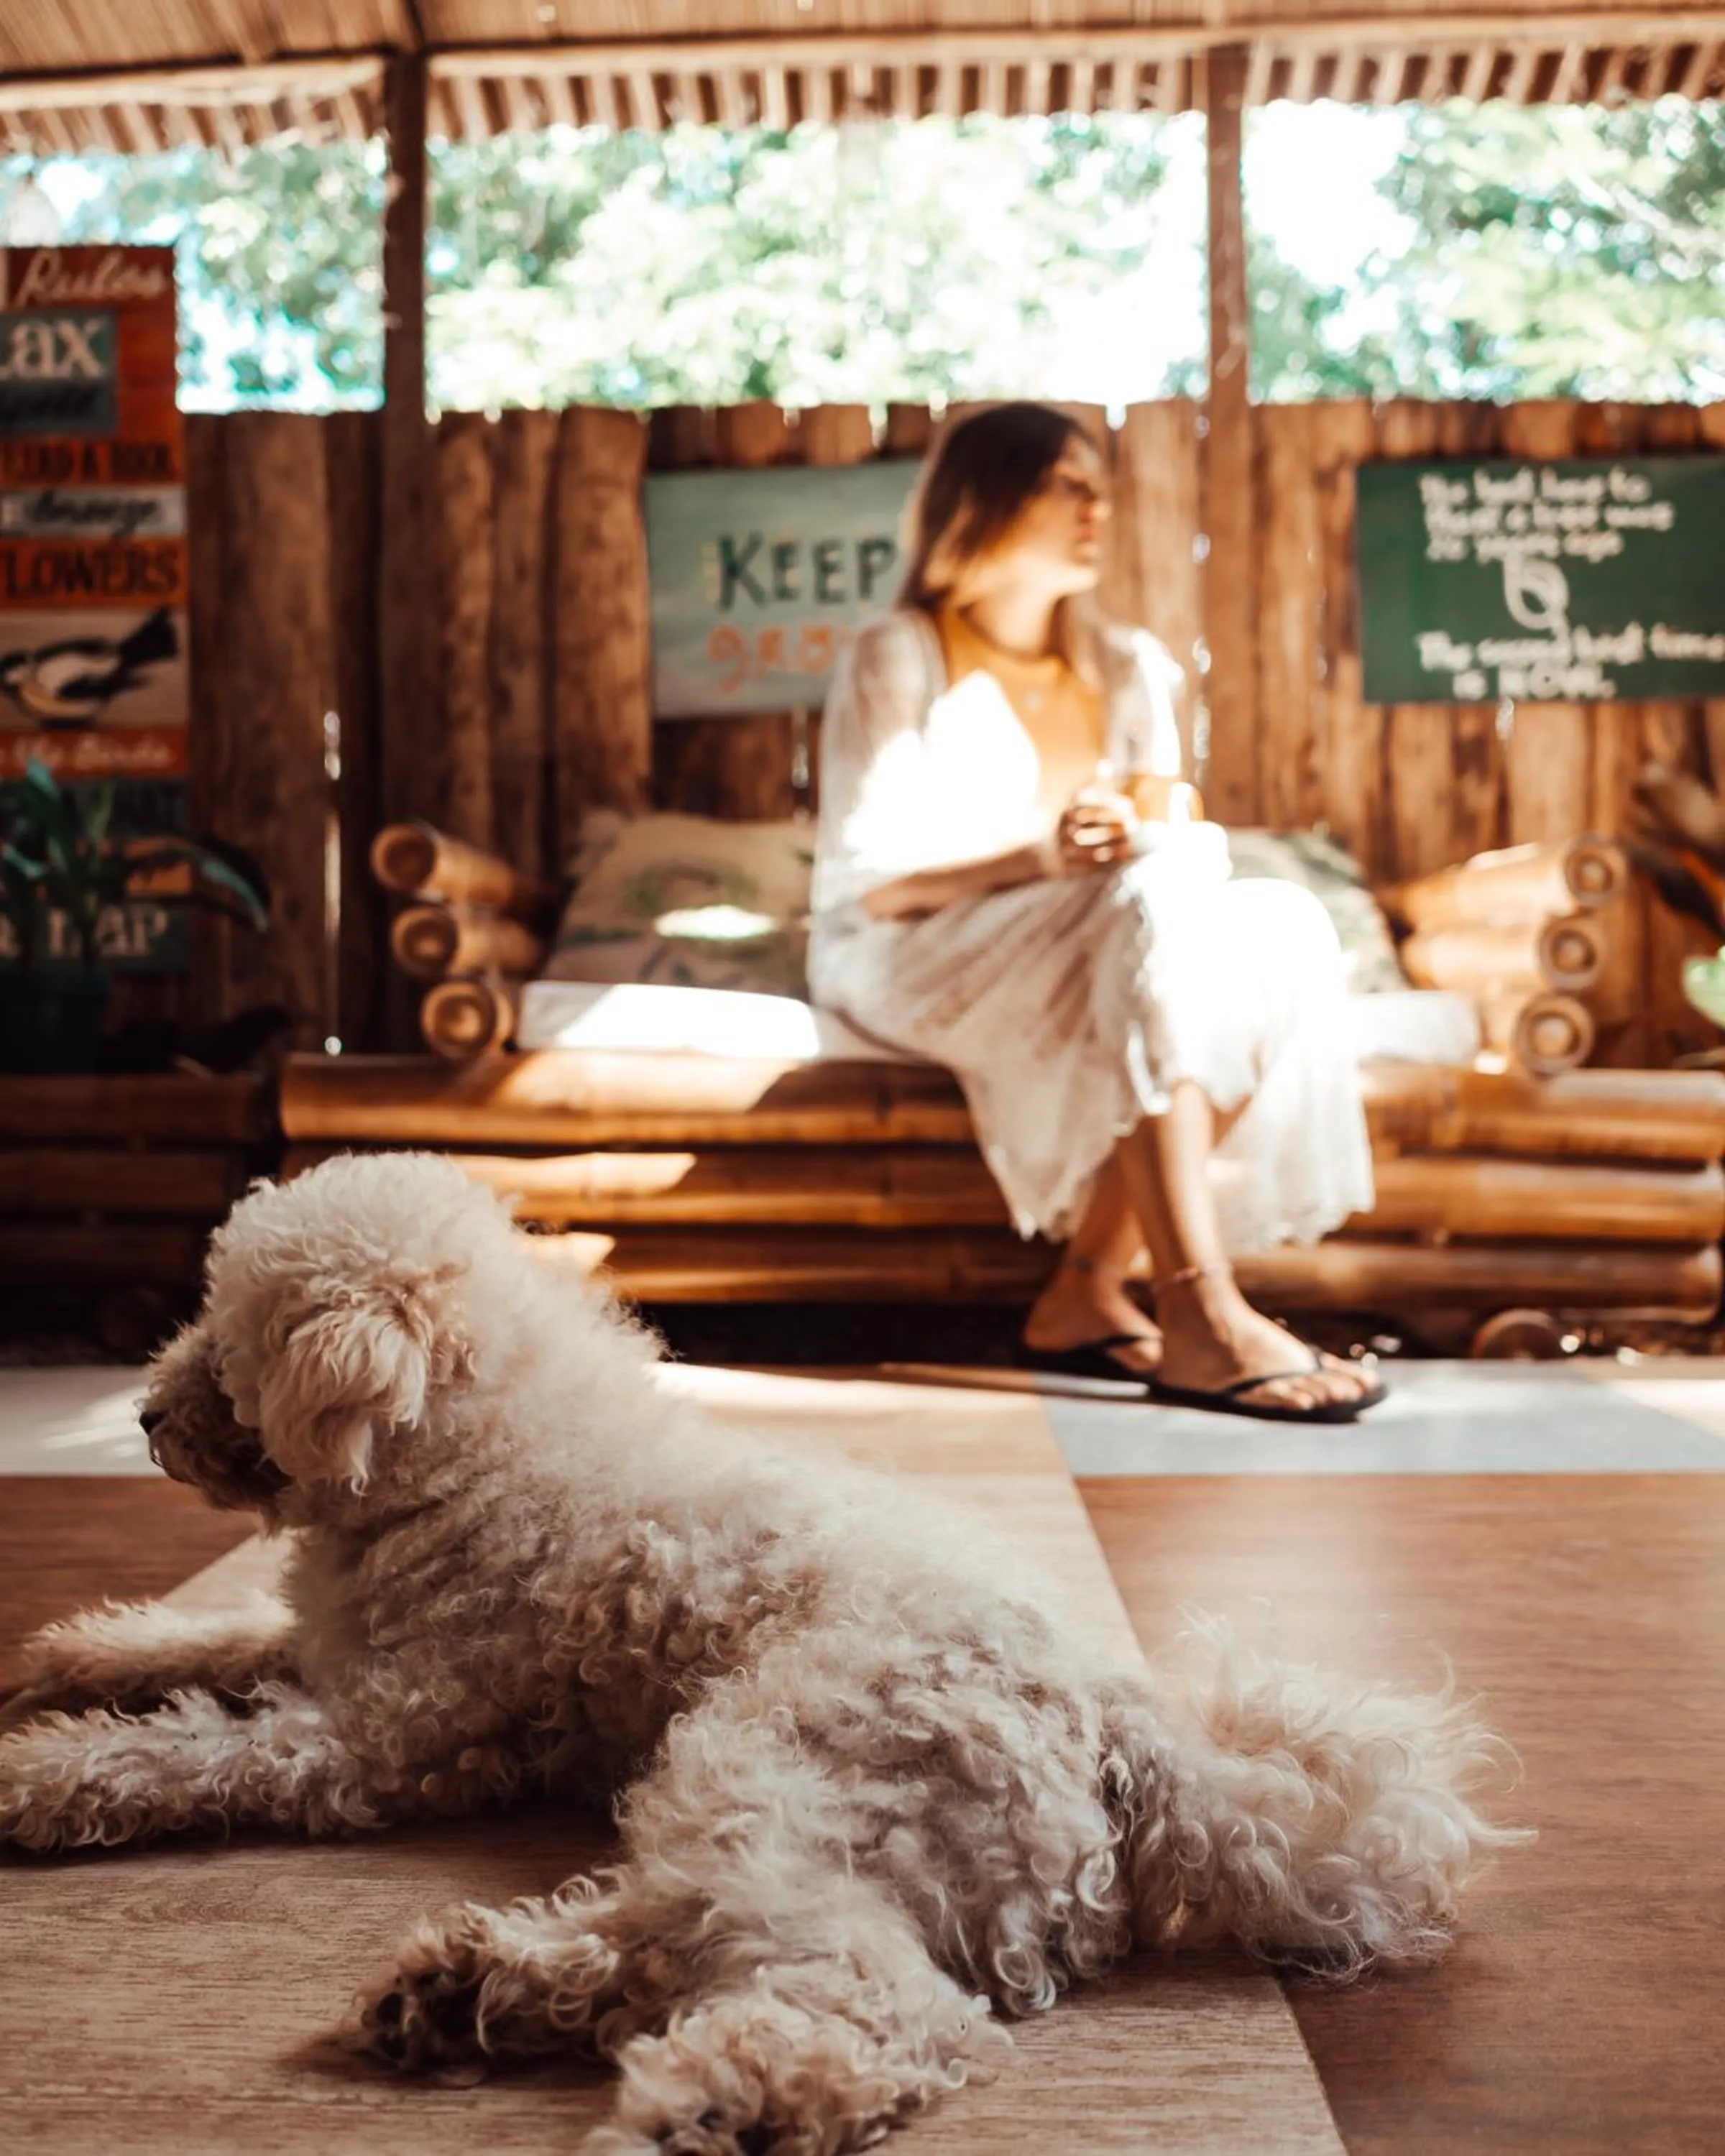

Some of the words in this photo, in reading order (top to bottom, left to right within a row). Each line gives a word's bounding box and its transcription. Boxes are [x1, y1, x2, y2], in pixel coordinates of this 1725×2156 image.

[0, 319, 106, 379] ax
[0, 546, 178, 599] LOWERS
[717, 529, 898, 612] KEEP
